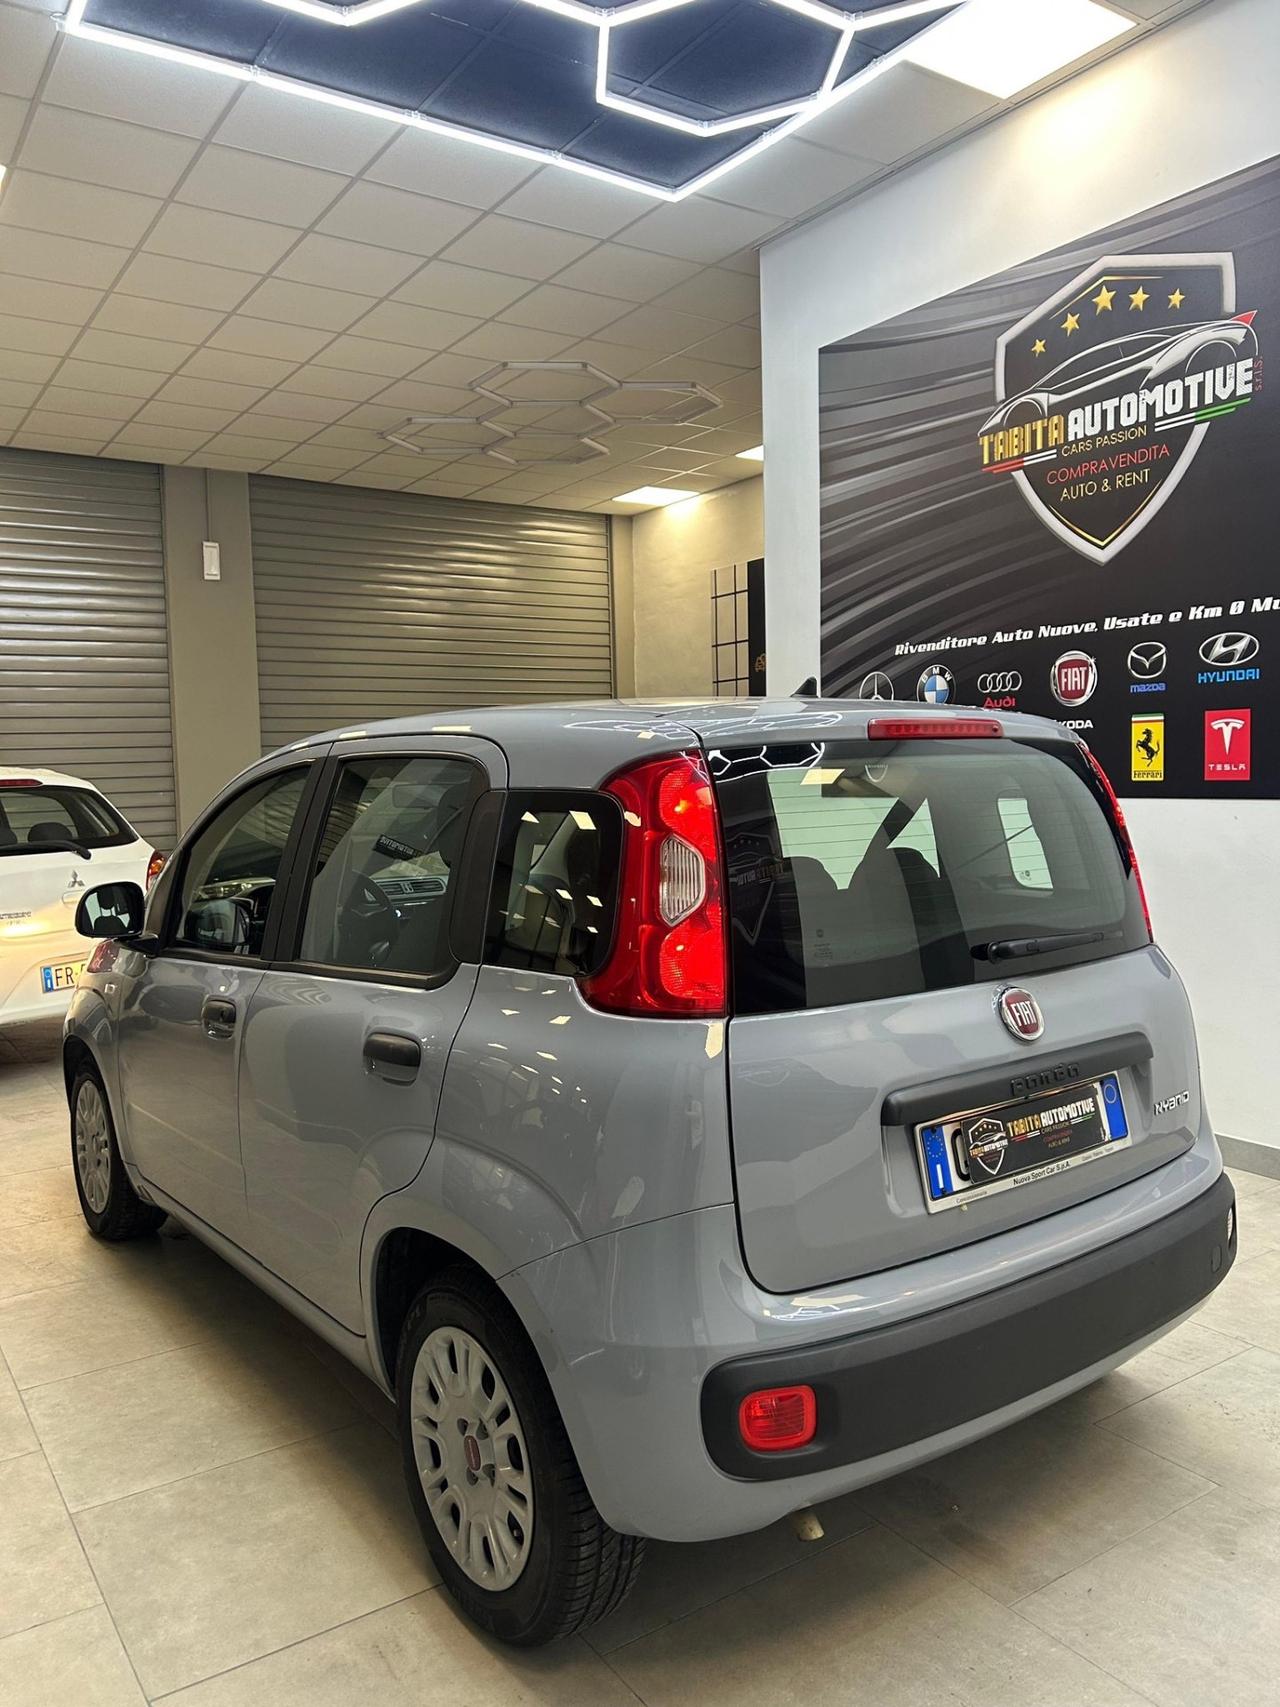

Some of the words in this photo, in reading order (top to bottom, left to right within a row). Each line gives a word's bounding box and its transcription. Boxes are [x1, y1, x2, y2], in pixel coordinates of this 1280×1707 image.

[979, 414, 1064, 465] TABITA
[1067, 358, 1253, 442] AUTOMOTIVE
[1061, 440, 1092, 457] CARS
[1095, 425, 1147, 447] PASSION
[1046, 444, 1170, 485] COMPRAVENDITA
[1060, 481, 1098, 502] AUTO
[1101, 478, 1112, 492] &
[1115, 468, 1151, 489] RENT
[894, 636, 987, 656] Rivenditore
[991, 627, 1034, 644] Auto
[1037, 621, 1098, 639] Nuove,
[1103, 612, 1163, 630] Usate
[1168, 611, 1182, 623] e
[1188, 605, 1222, 620] Km
[921, 666, 953, 684] BMW
[1061, 666, 1087, 692] FIAT
[1198, 668, 1260, 684] HYUNDAI
[983, 696, 1016, 709] Audi
[1133, 770, 1163, 779] Ferrari
[1208, 763, 1246, 771] TESLA
[1010, 1000, 1037, 1027] FIAT
[1040, 1098, 1096, 1127] AUTOMOTIVE
[1013, 1175, 1031, 1186] Nuova
[1031, 1169, 1046, 1181] Sport
[1045, 1166, 1056, 1176] Car
